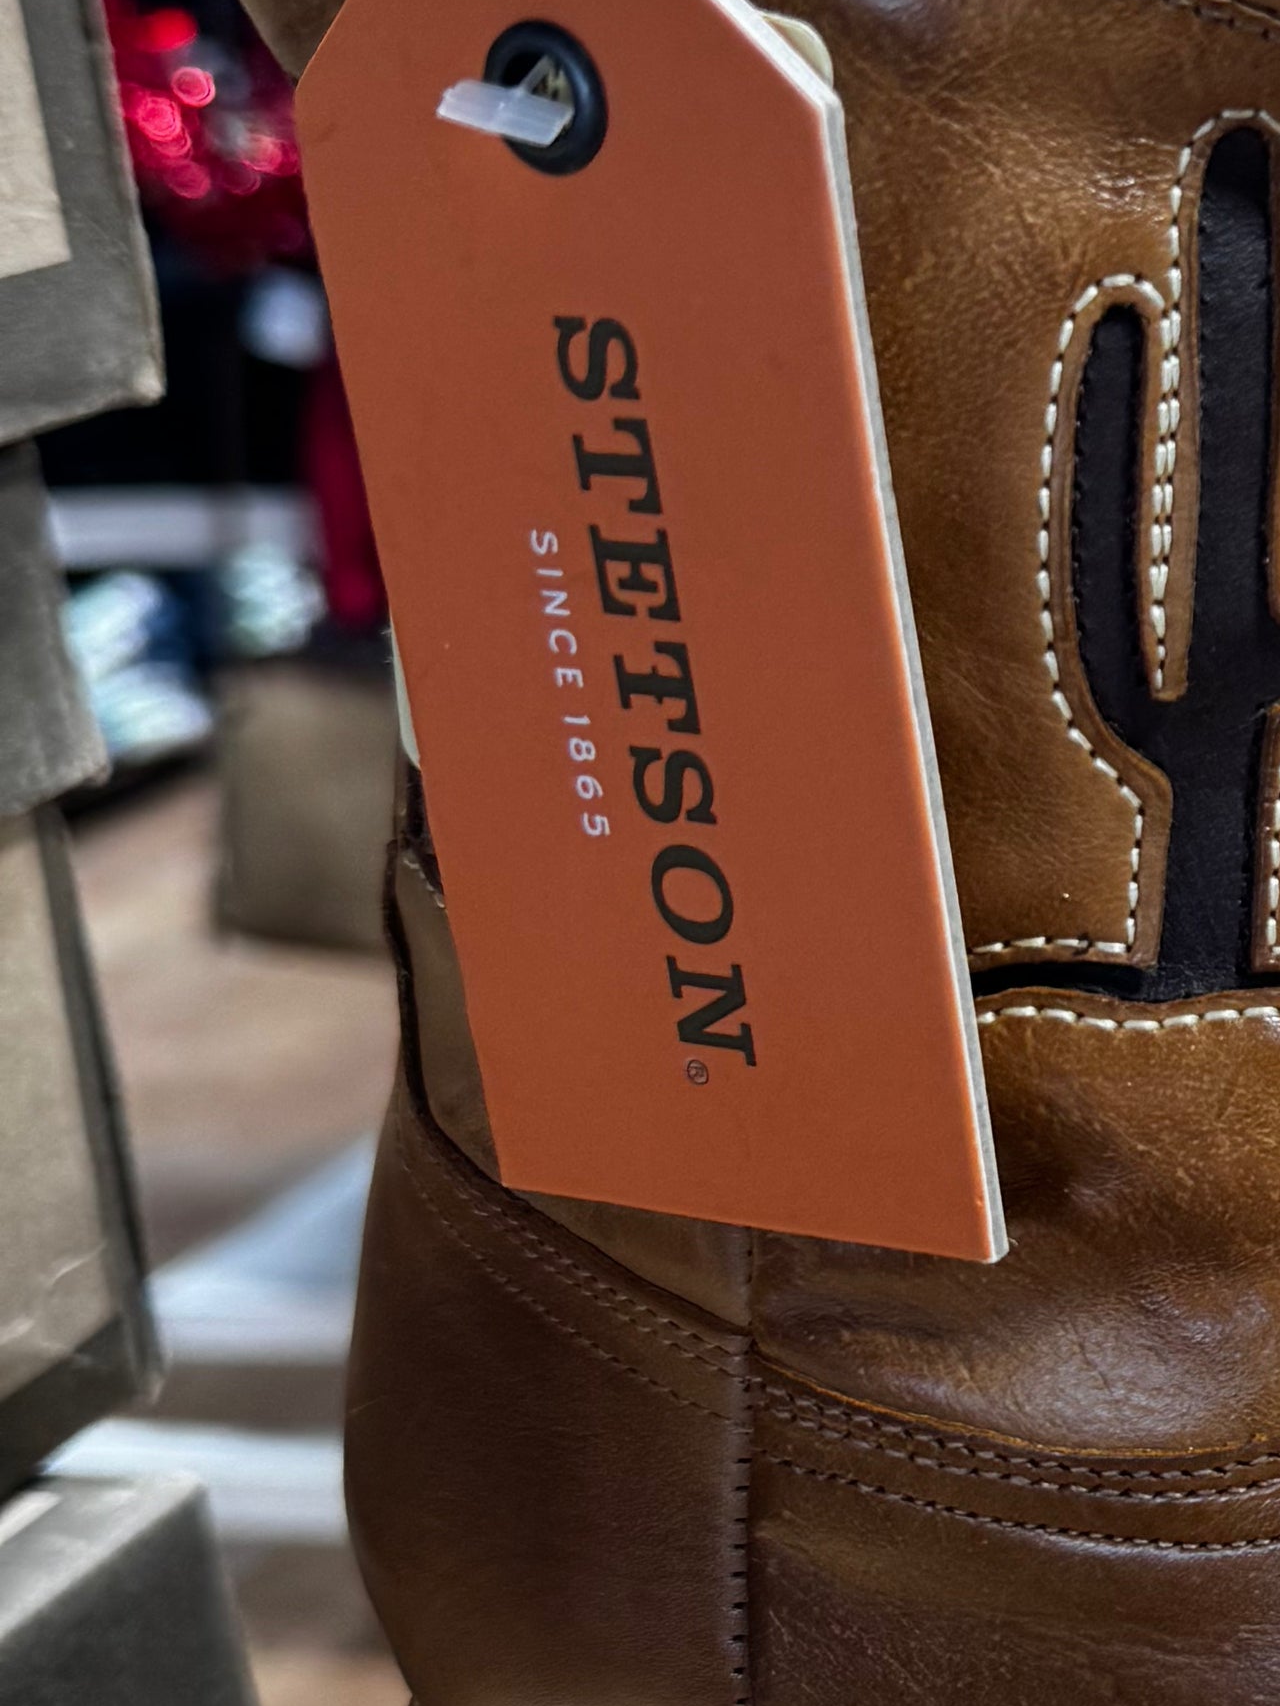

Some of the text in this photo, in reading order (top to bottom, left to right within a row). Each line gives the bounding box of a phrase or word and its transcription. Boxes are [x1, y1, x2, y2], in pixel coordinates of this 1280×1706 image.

[530, 528, 611, 838] SINCE 1865
[551, 315, 758, 1069] STETSON
